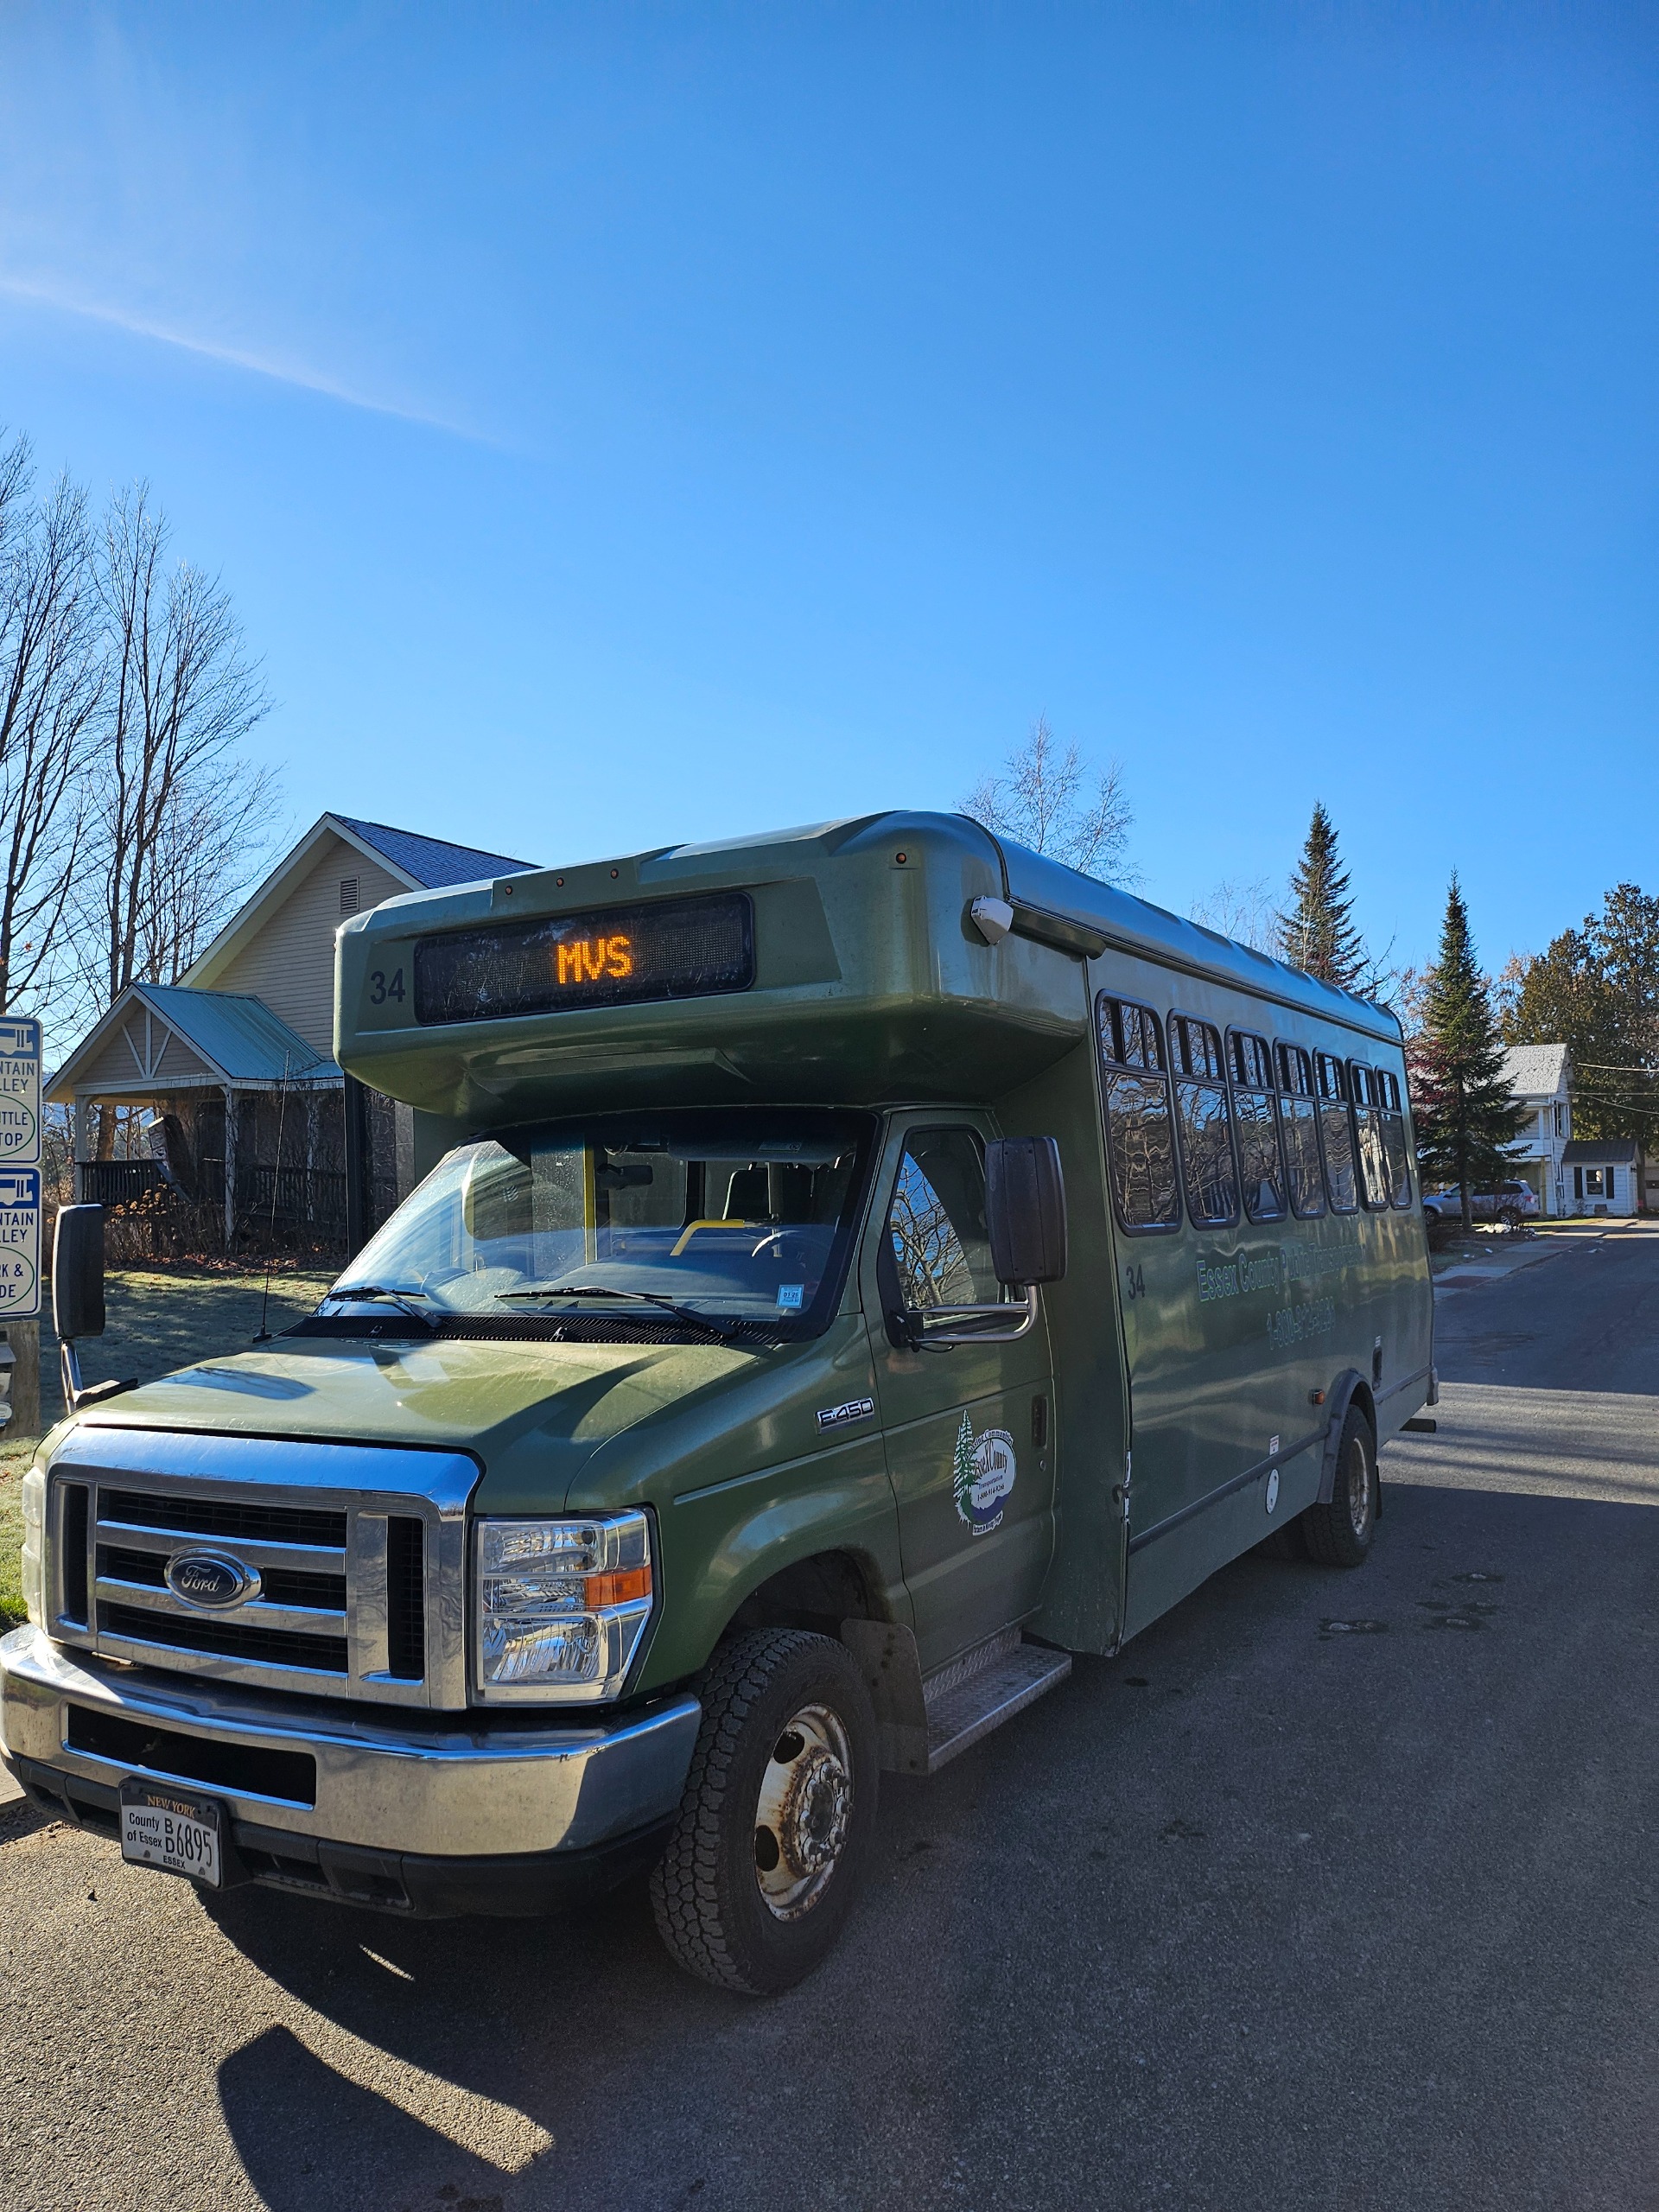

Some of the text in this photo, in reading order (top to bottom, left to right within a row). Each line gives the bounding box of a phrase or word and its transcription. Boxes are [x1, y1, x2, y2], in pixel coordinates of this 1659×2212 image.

[556, 936, 632, 985] MVS
[370, 968, 406, 1005] 34
[0, 1077, 29, 1092] LEY
[0, 1111, 29, 1125] TTLE
[0, 1229, 28, 1243] LEY
[14, 1263, 24, 1276] &
[1196, 1259, 1239, 1302] Essex
[1239, 1250, 1280, 1295] County
[1126, 1263, 1146, 1300] 34
[181, 1565, 219, 1592] Ford
[147, 1795, 196, 1819] NEW YORK
[129, 1812, 160, 1832] County
[127, 1830, 162, 1848] of Essex
[176, 1822, 213, 1867] 6895
[162, 1855, 186, 1870] ESSEX
